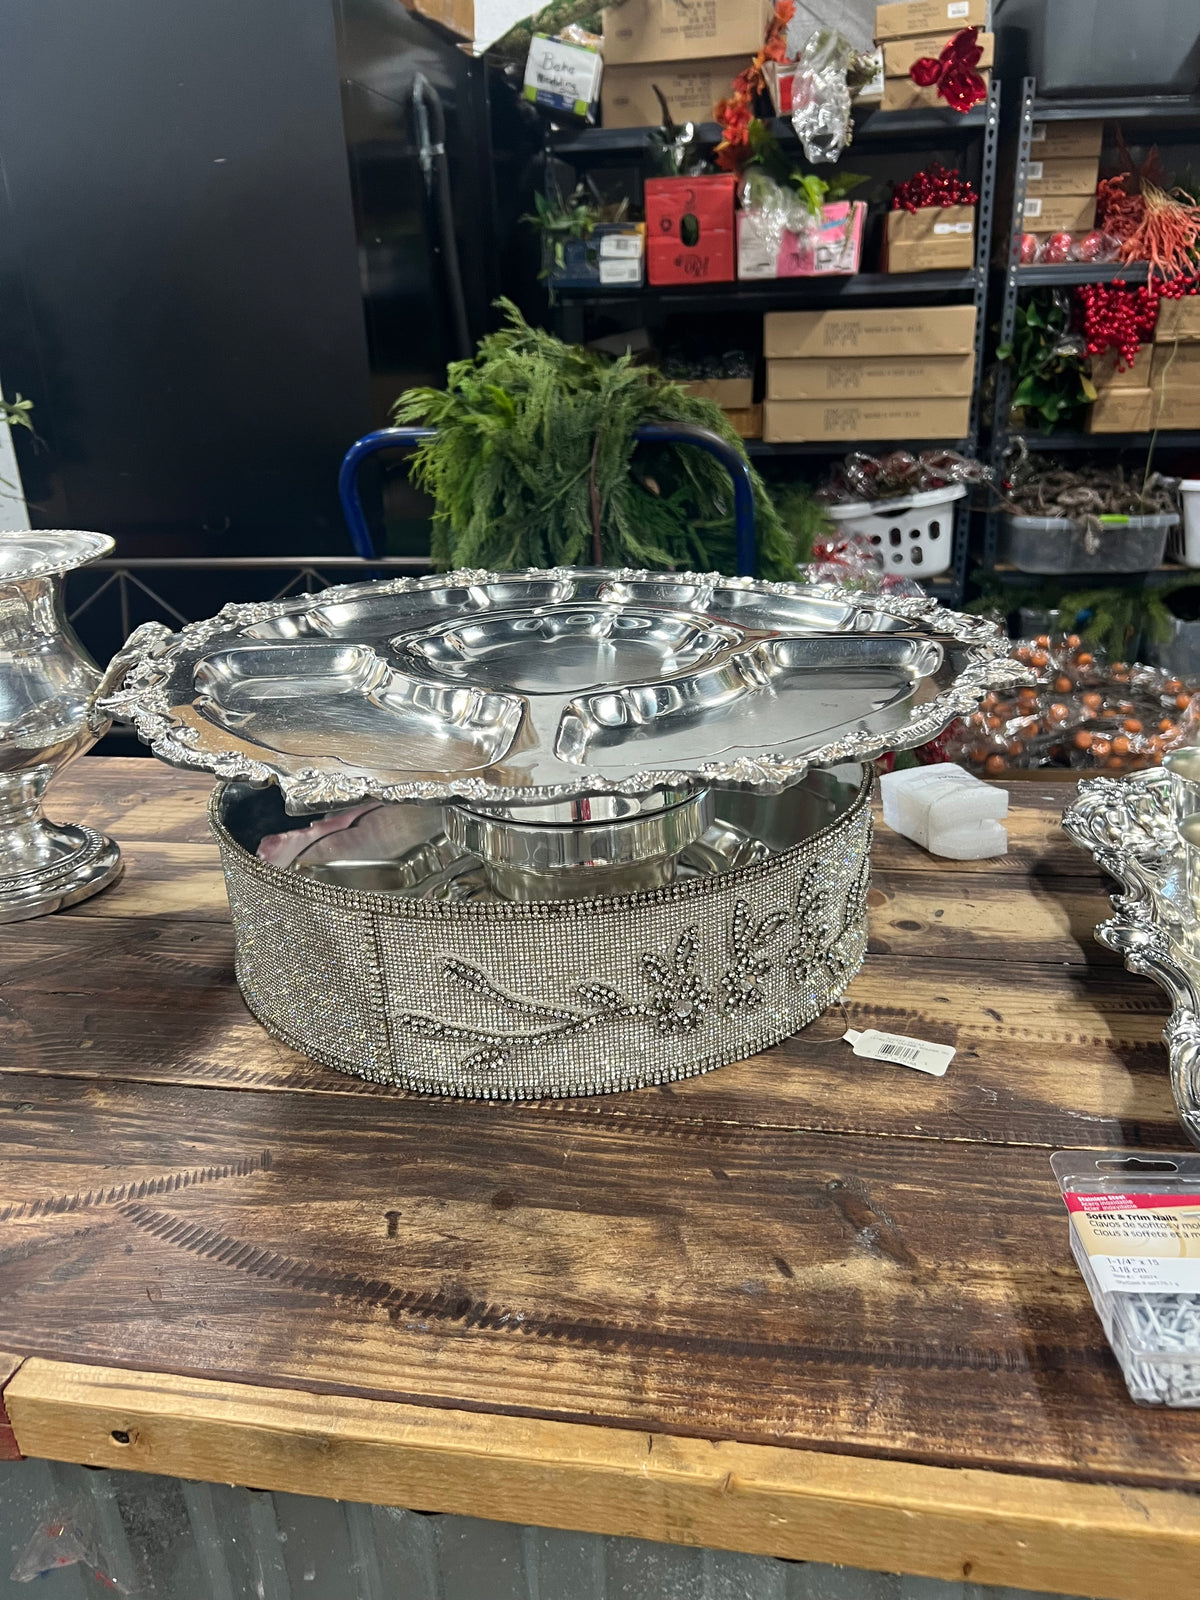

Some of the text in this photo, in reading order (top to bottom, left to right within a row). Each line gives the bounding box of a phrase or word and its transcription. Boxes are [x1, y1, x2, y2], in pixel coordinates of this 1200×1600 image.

[1086, 1212, 1115, 1221] Soffit
[1117, 1213, 1125, 1221] &
[1152, 1214, 1178, 1222] Nails
[1089, 1220, 1121, 1228] Clavos
[1122, 1221, 1135, 1229] de
[1174, 1223, 1180, 1231] y
[1093, 1228, 1121, 1237] Clous
[1169, 1231, 1181, 1239] et
